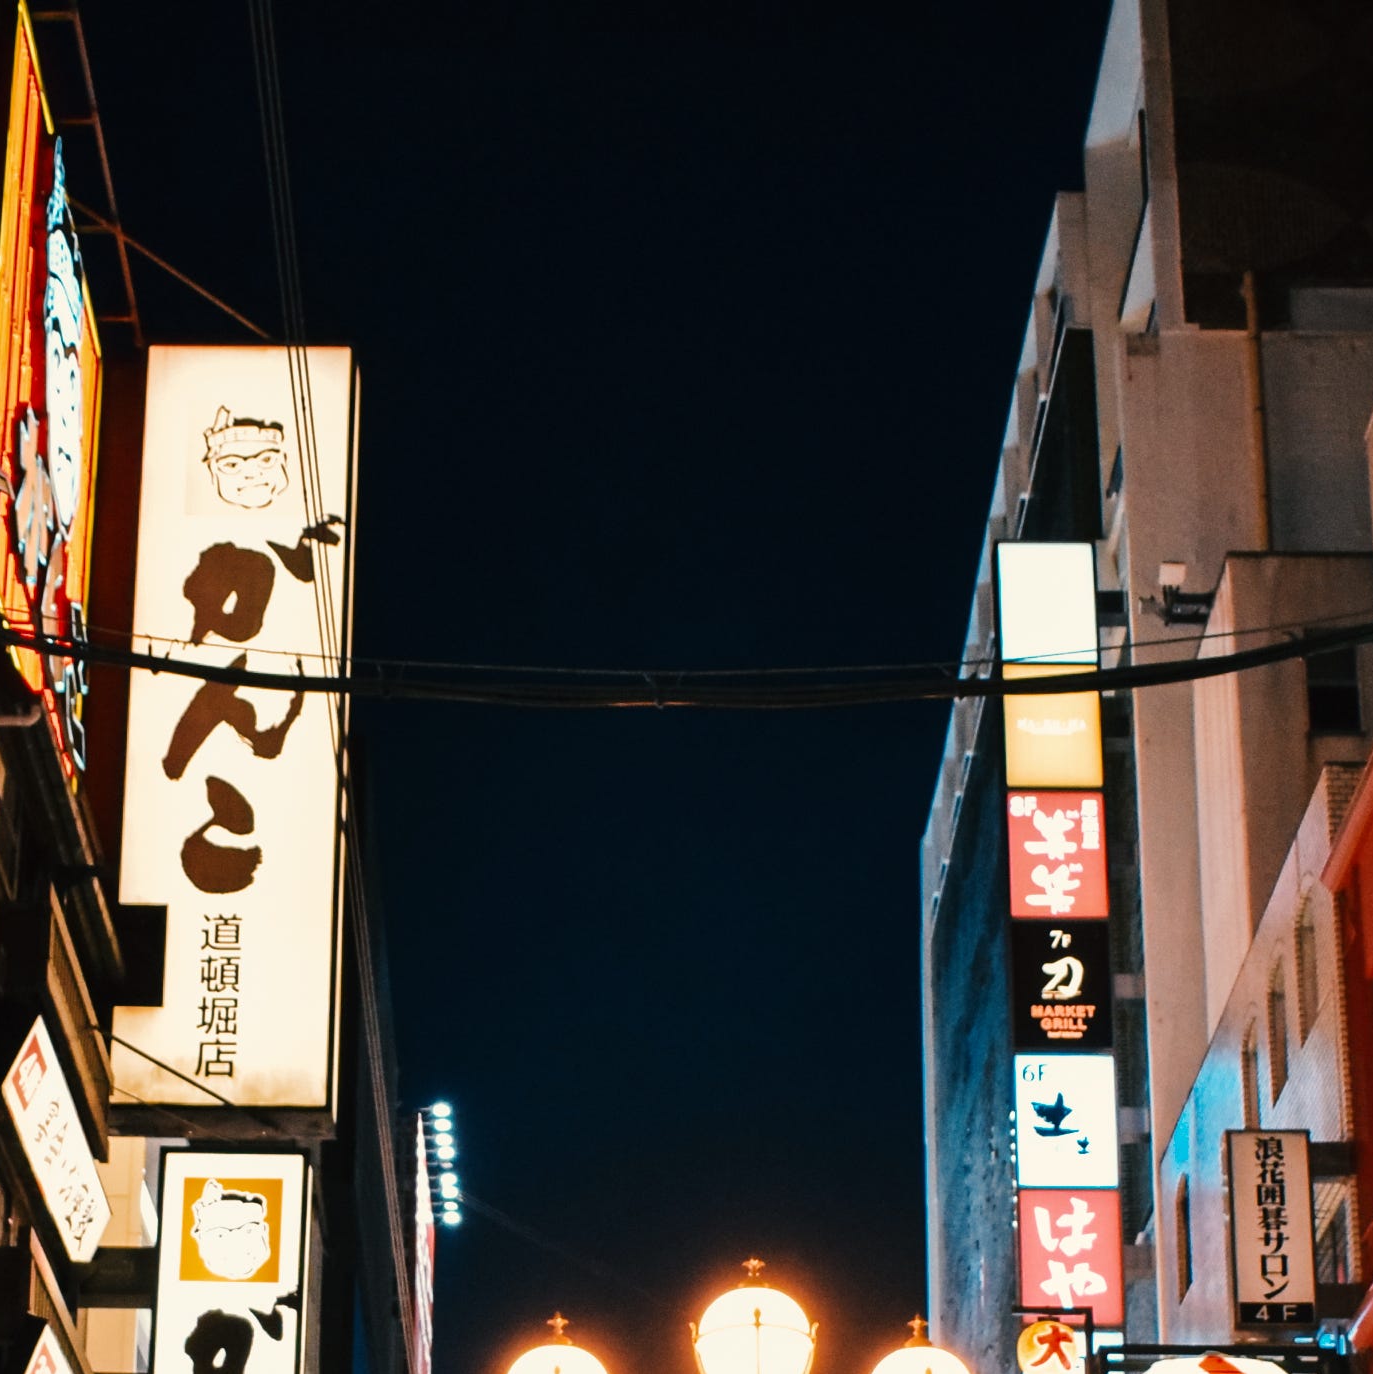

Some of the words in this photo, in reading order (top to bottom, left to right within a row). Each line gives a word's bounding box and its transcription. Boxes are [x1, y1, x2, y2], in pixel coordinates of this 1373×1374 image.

[162, 513, 346, 894] がんこ
[1049, 930, 1072, 948] 7F
[195, 912, 242, 1078] 道頓堀店
[1031, 1005, 1095, 1018] MARKET
[1040, 1017, 1087, 1031] GRILL
[1023, 1064, 1049, 1083] 6F
[1255, 1137, 1290, 1299] 浪花囲碁サロン
